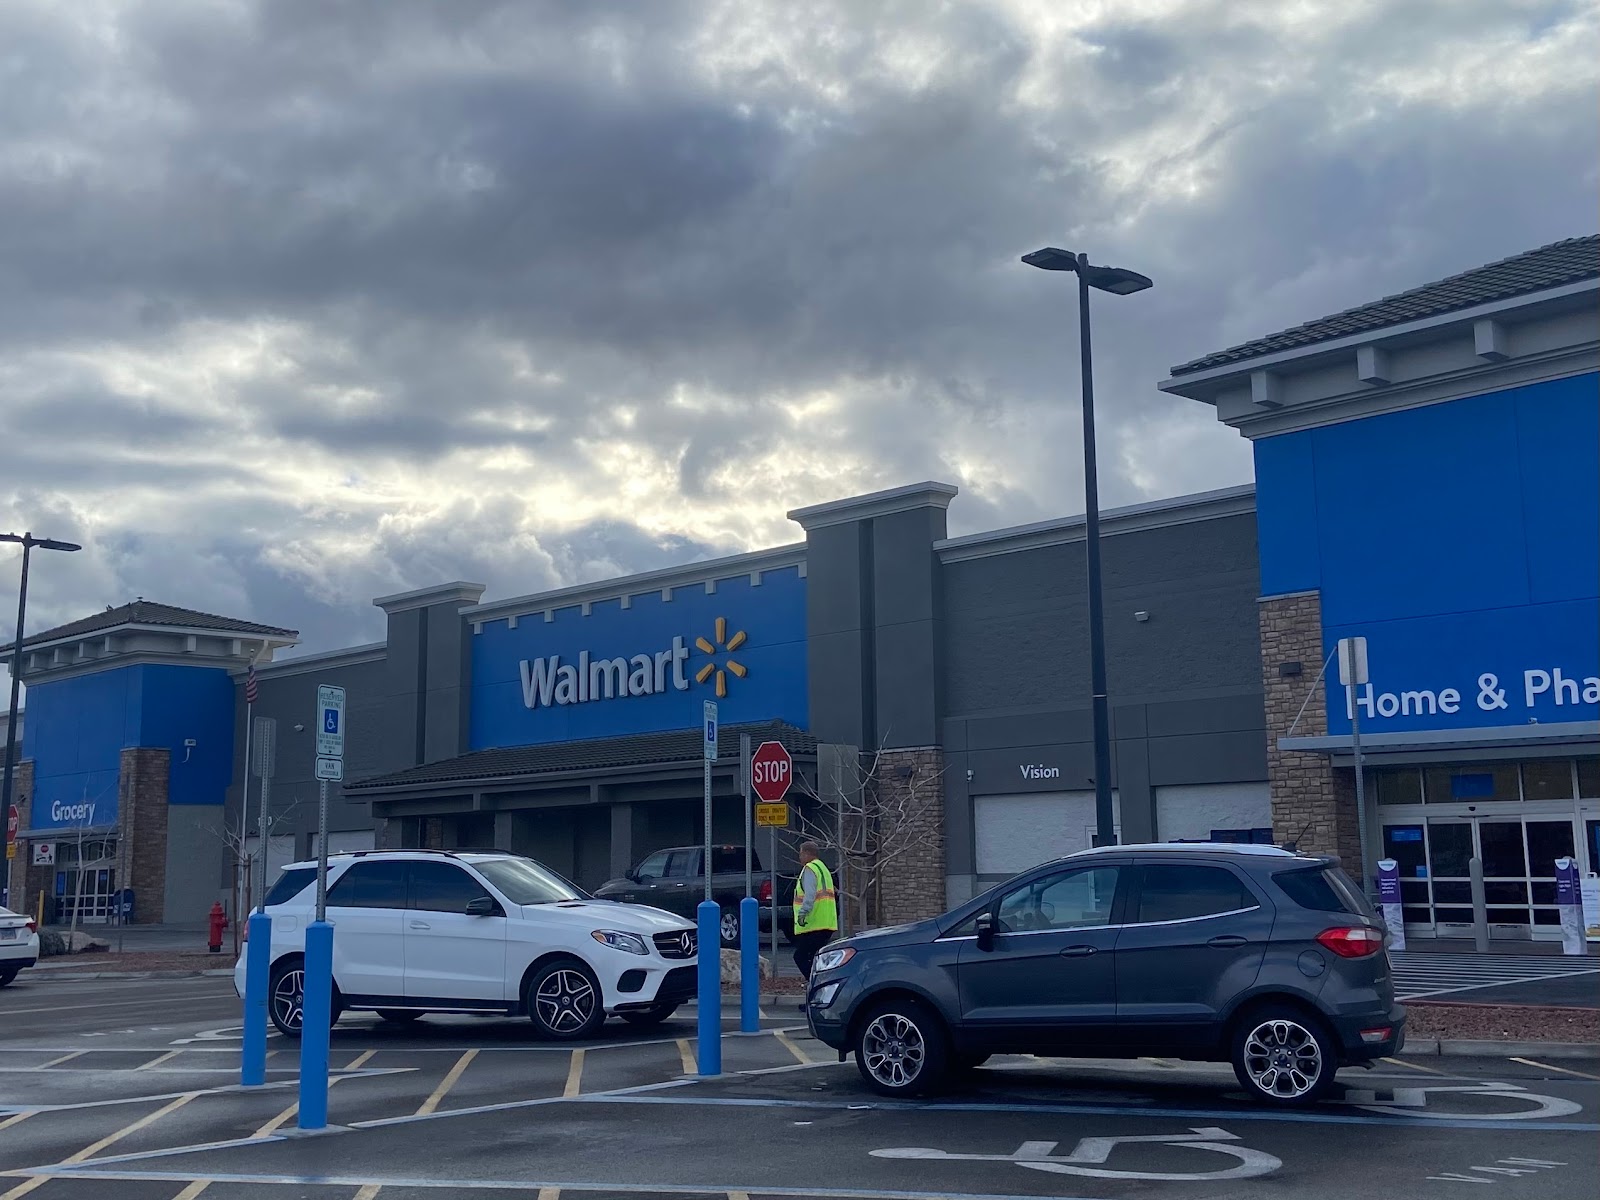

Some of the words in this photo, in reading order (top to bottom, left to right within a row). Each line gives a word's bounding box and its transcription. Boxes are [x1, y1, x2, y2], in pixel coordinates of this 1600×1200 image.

[519, 635, 690, 710] Walmart
[1345, 682, 1461, 720] Home
[1476, 672, 1508, 711] &
[1524, 667, 1600, 708] Pha
[324, 762, 335, 770] VAN
[754, 760, 789, 784] STOP
[1019, 764, 1060, 780] Vision
[8, 816, 18, 832] TOP
[51, 800, 96, 825] Grocery
[1425, 1156, 1568, 1184] VAN
